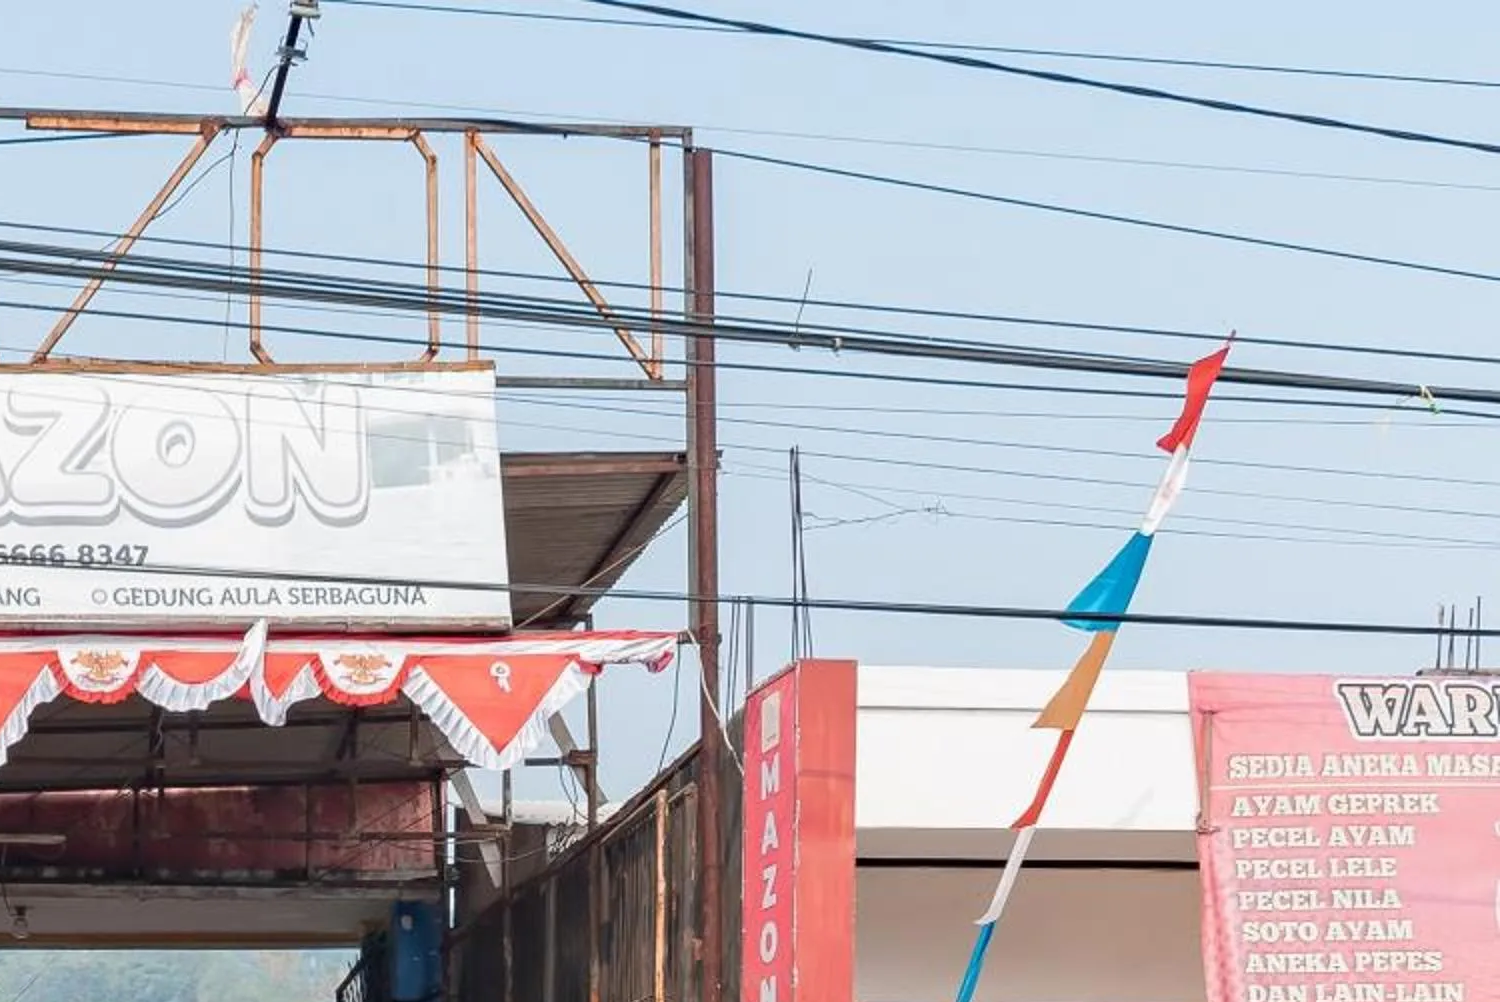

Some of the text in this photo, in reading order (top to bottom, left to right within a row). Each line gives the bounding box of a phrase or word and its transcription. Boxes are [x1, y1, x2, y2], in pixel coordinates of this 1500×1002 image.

[77, 544, 149, 567] 8347
[113, 585, 427, 607] GEDUNG AULA SERBAGUNA
[1337, 683, 1500, 737] WAR
[1228, 754, 1314, 780] SEDIA
[1321, 753, 1419, 778] ANEKA
[1231, 793, 1440, 817] AYAM GEPREK
[1231, 825, 1416, 849] PECEL AYAM
[1235, 857, 1398, 879] PECEL LELE
[1237, 889, 1402, 911] PECEL NILA
[1242, 920, 1414, 942] SOTO AYAM
[1245, 951, 1443, 973] ANEKA PEPES
